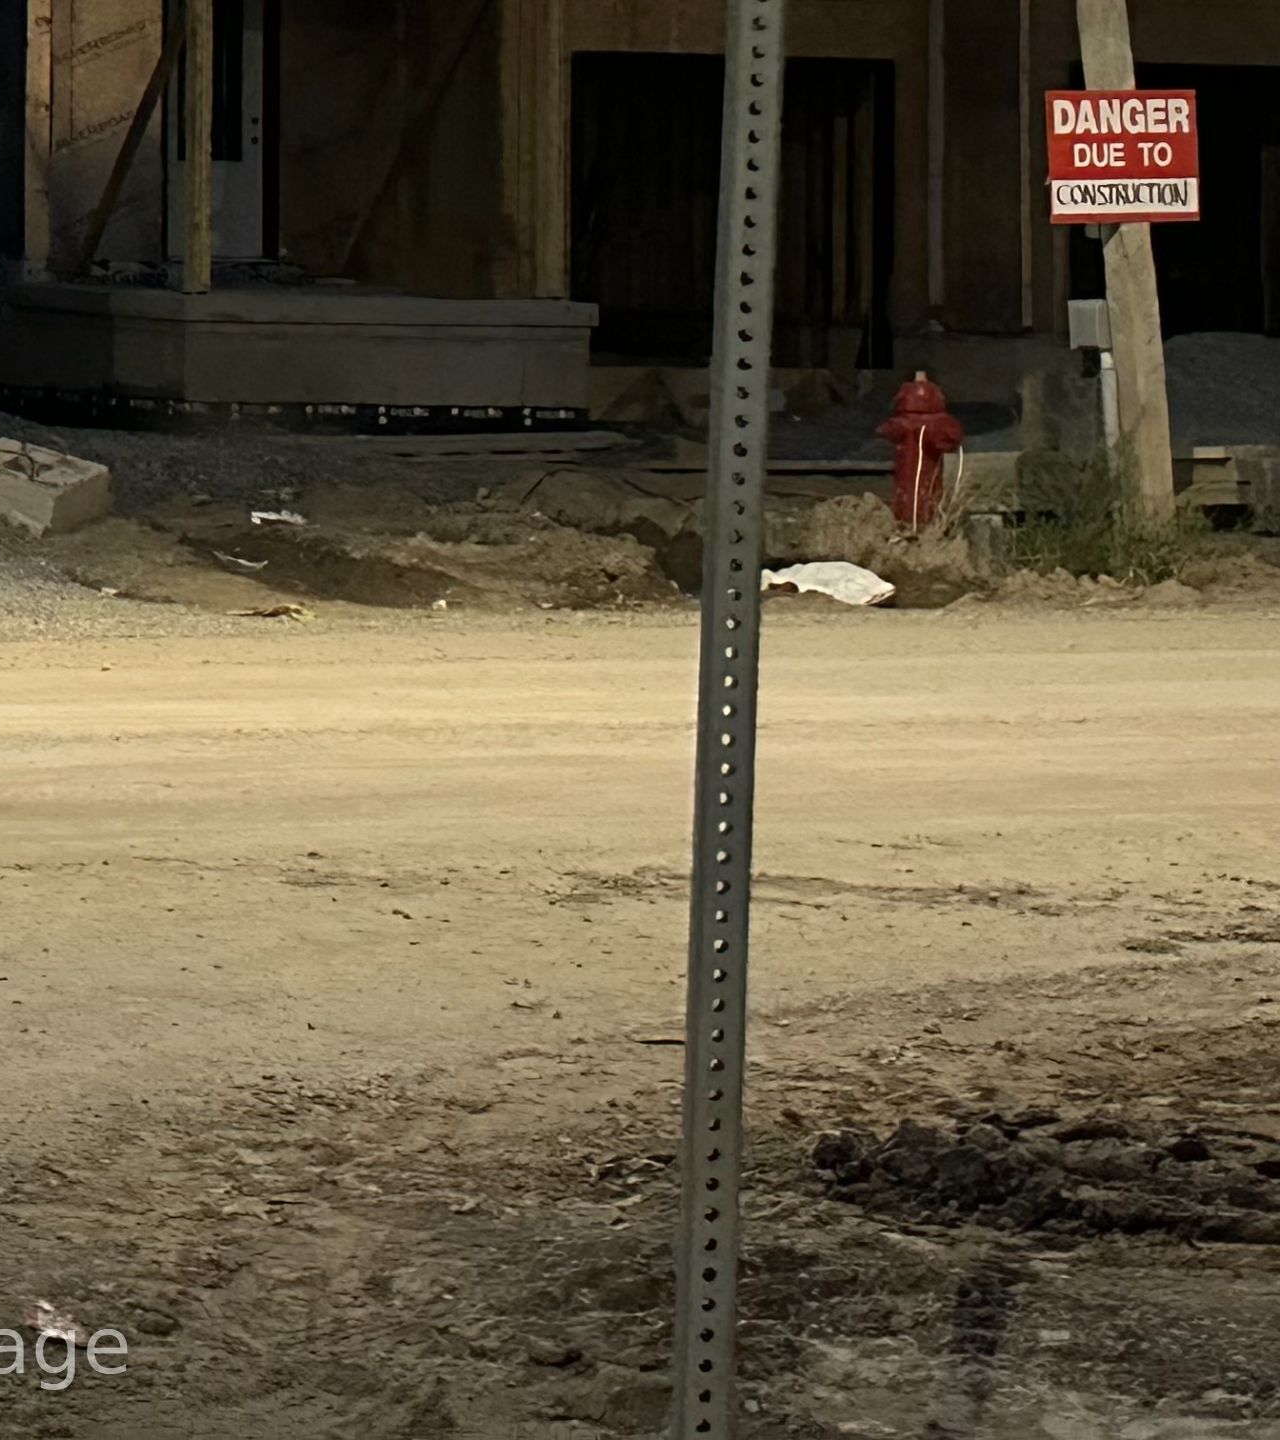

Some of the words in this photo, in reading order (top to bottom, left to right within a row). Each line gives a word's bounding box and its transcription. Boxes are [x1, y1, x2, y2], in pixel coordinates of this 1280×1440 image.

[1052, 97, 1190, 135] DANGER
[1073, 142, 1126, 168] DUE
[1137, 141, 1173, 167] TO
[1056, 179, 1189, 207] CONSTRUCTION
